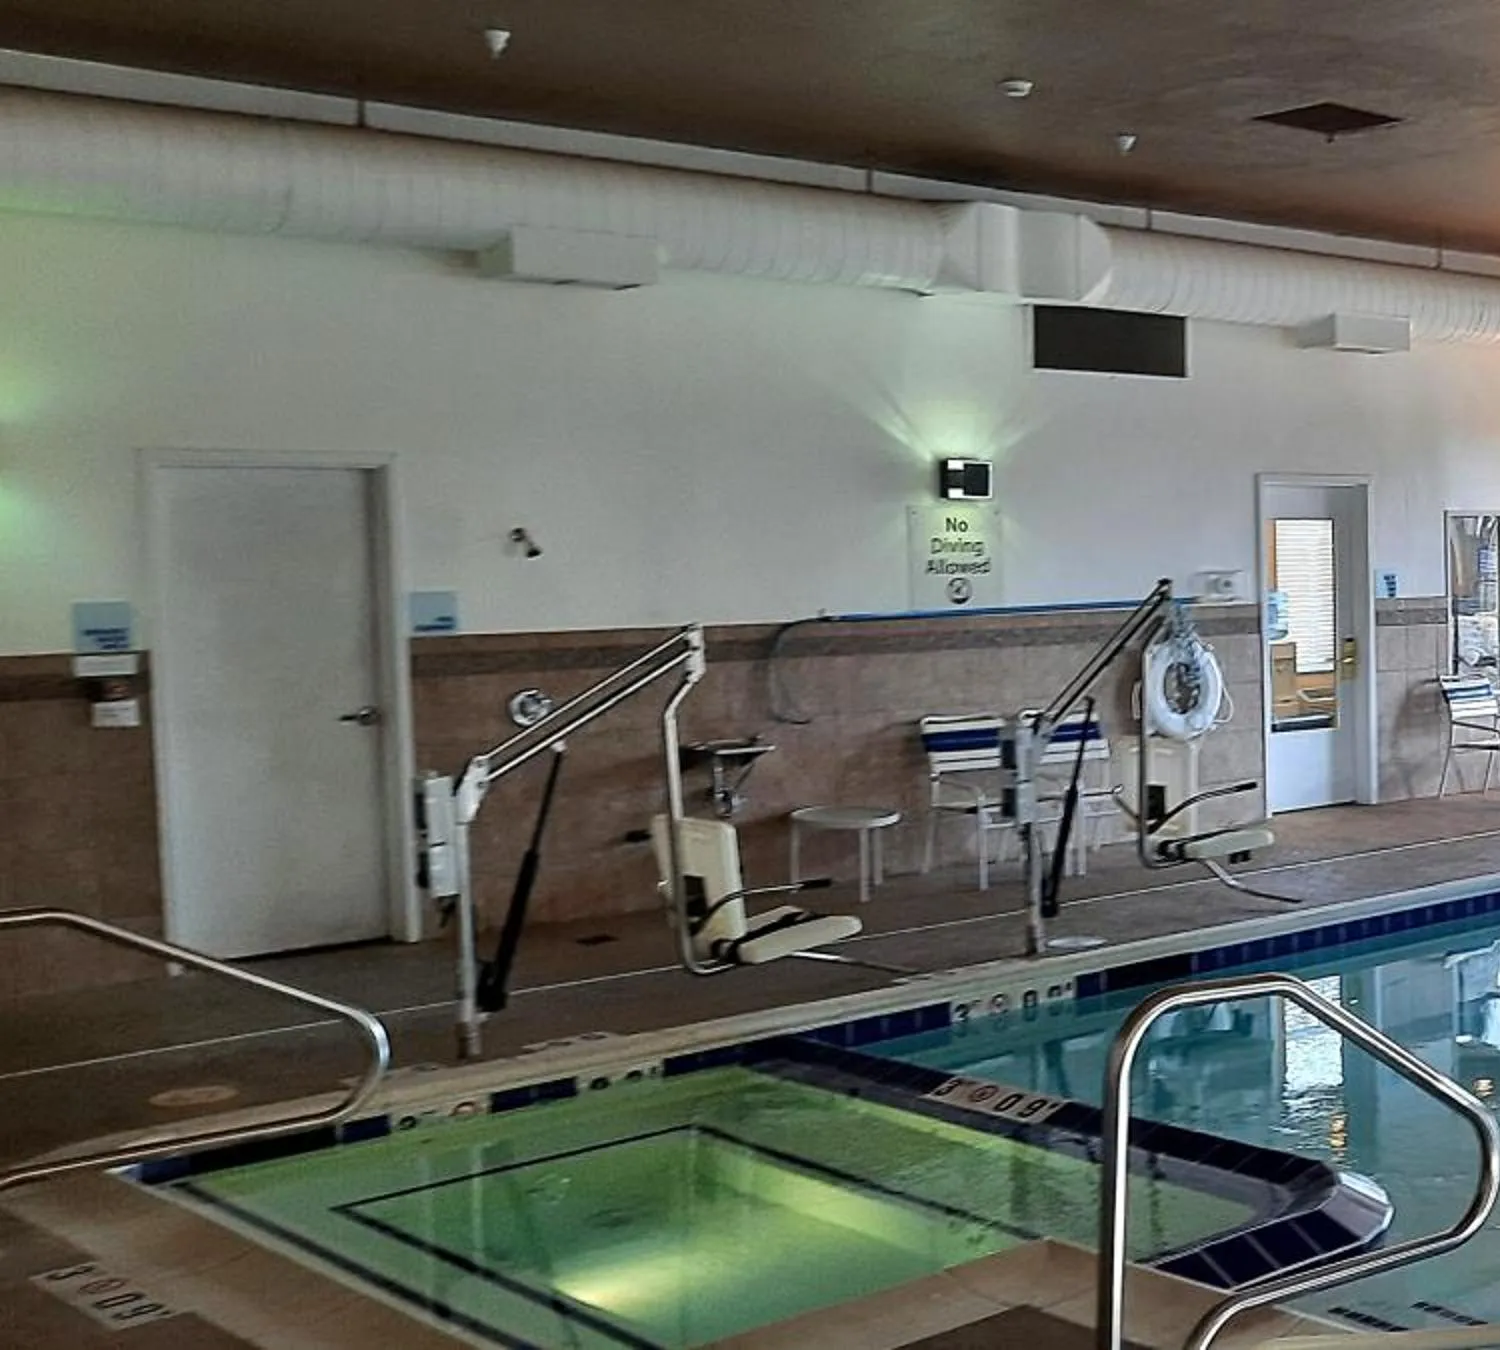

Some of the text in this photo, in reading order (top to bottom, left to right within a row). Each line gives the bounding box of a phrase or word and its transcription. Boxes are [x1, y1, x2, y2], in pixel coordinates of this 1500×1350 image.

[945, 517, 969, 532] No
[930, 537, 985, 556] Diving
[925, 558, 992, 575] Allowed
